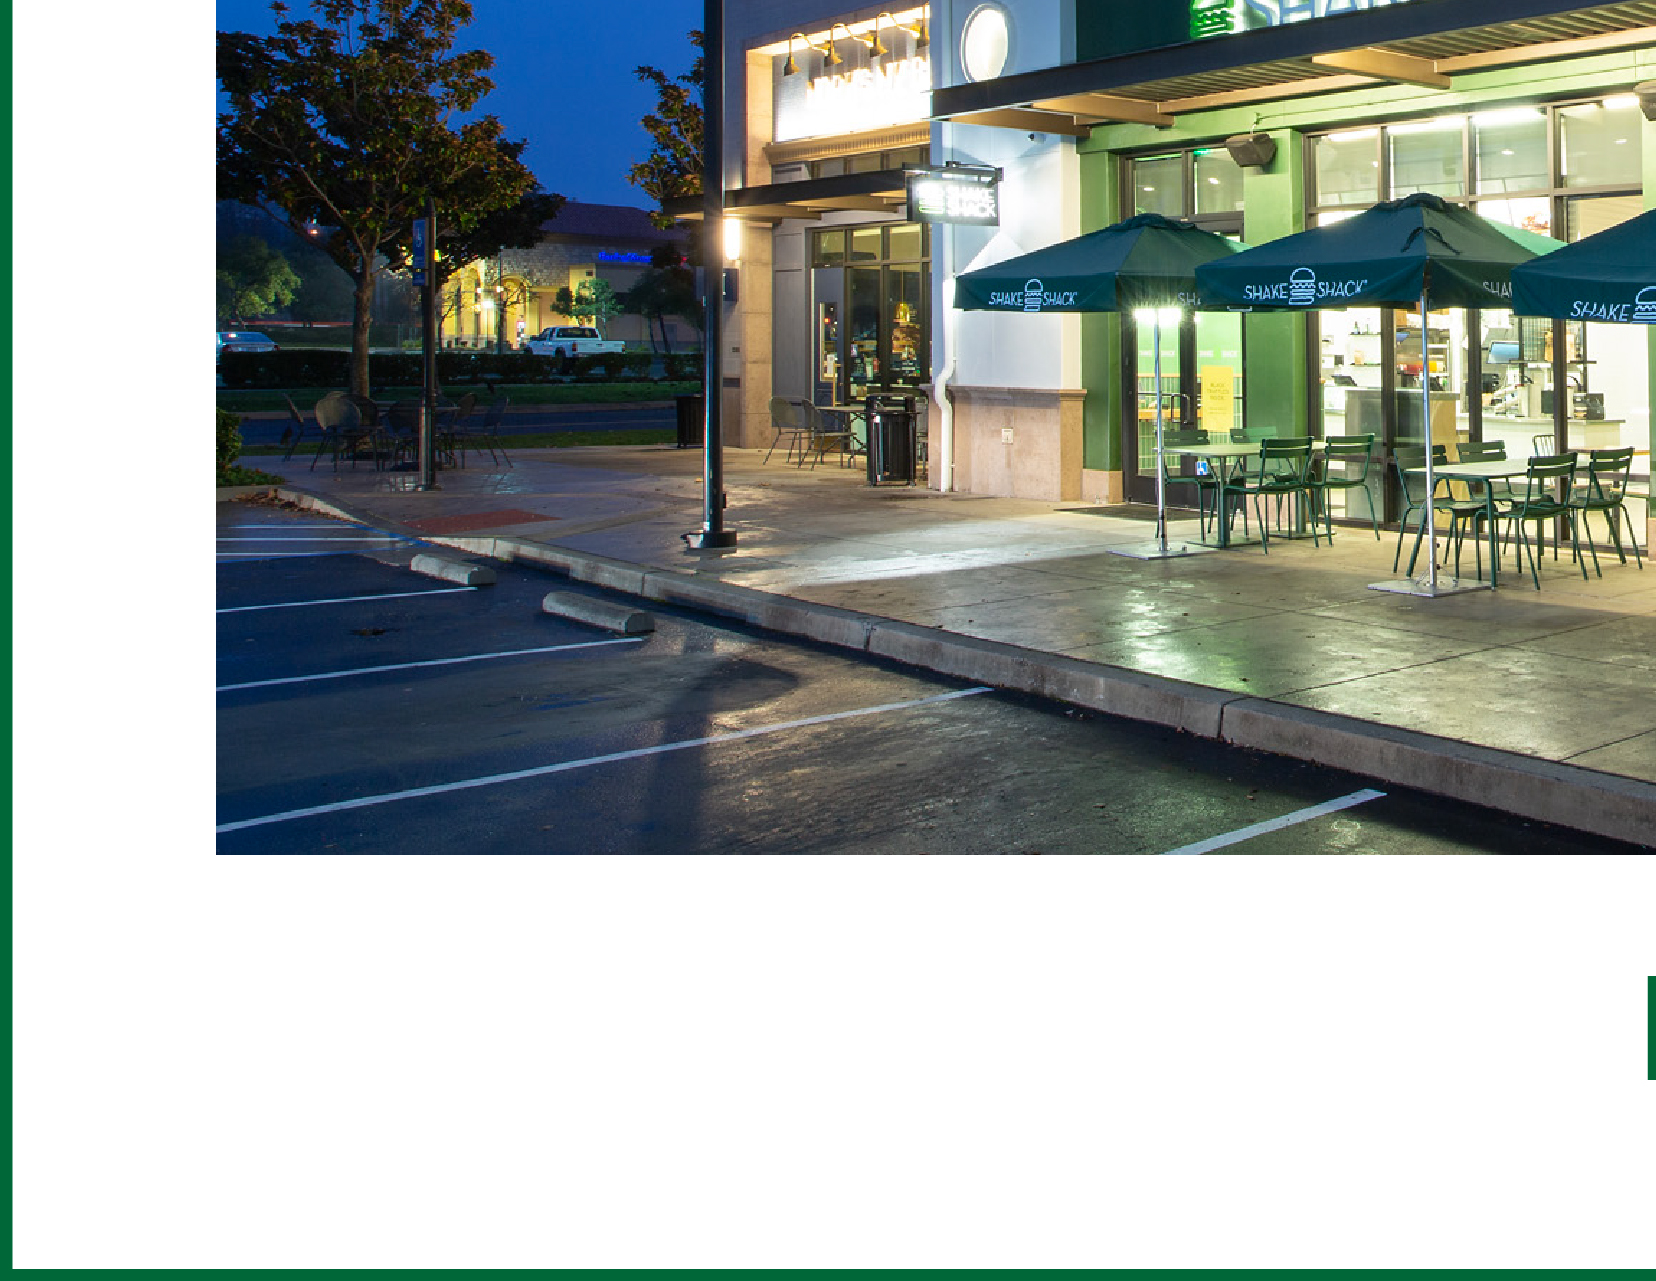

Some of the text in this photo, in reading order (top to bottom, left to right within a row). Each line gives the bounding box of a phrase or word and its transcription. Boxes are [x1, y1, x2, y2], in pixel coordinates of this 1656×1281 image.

[988, 291, 1076, 306] SHAKE SHACK
[1240, 280, 1363, 300] SHAKE SHACK
[1482, 280, 1512, 299] SHA
[1570, 300, 1631, 322] SHAKE
